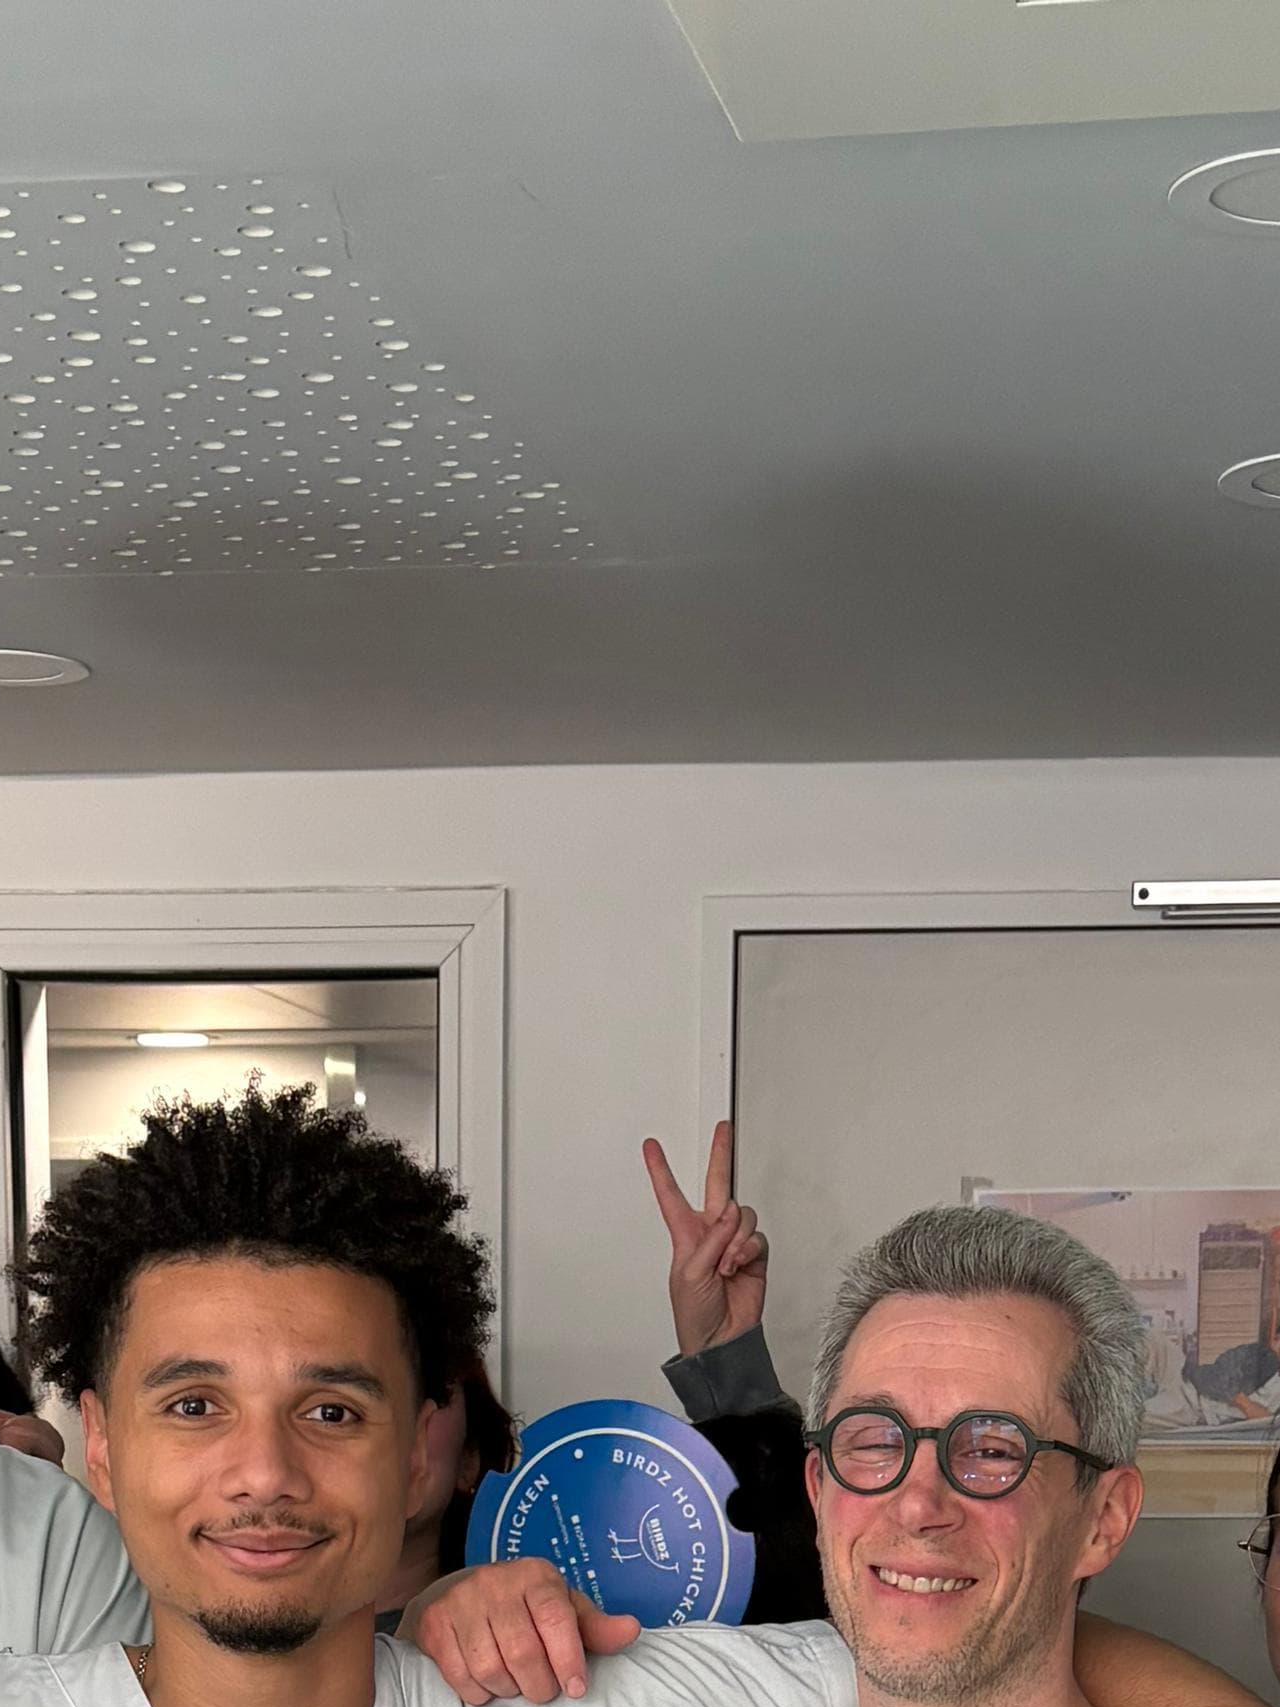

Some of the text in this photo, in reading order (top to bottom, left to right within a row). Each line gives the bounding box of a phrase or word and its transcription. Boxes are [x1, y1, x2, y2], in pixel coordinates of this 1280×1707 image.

[613, 1448, 672, 1488] BIRDZ
[506, 1473, 550, 1562] HICKEN
[671, 1487, 703, 1531] HOT
[650, 1518, 670, 1561] BIRDZ
[667, 1541, 706, 1626] CHICKE
